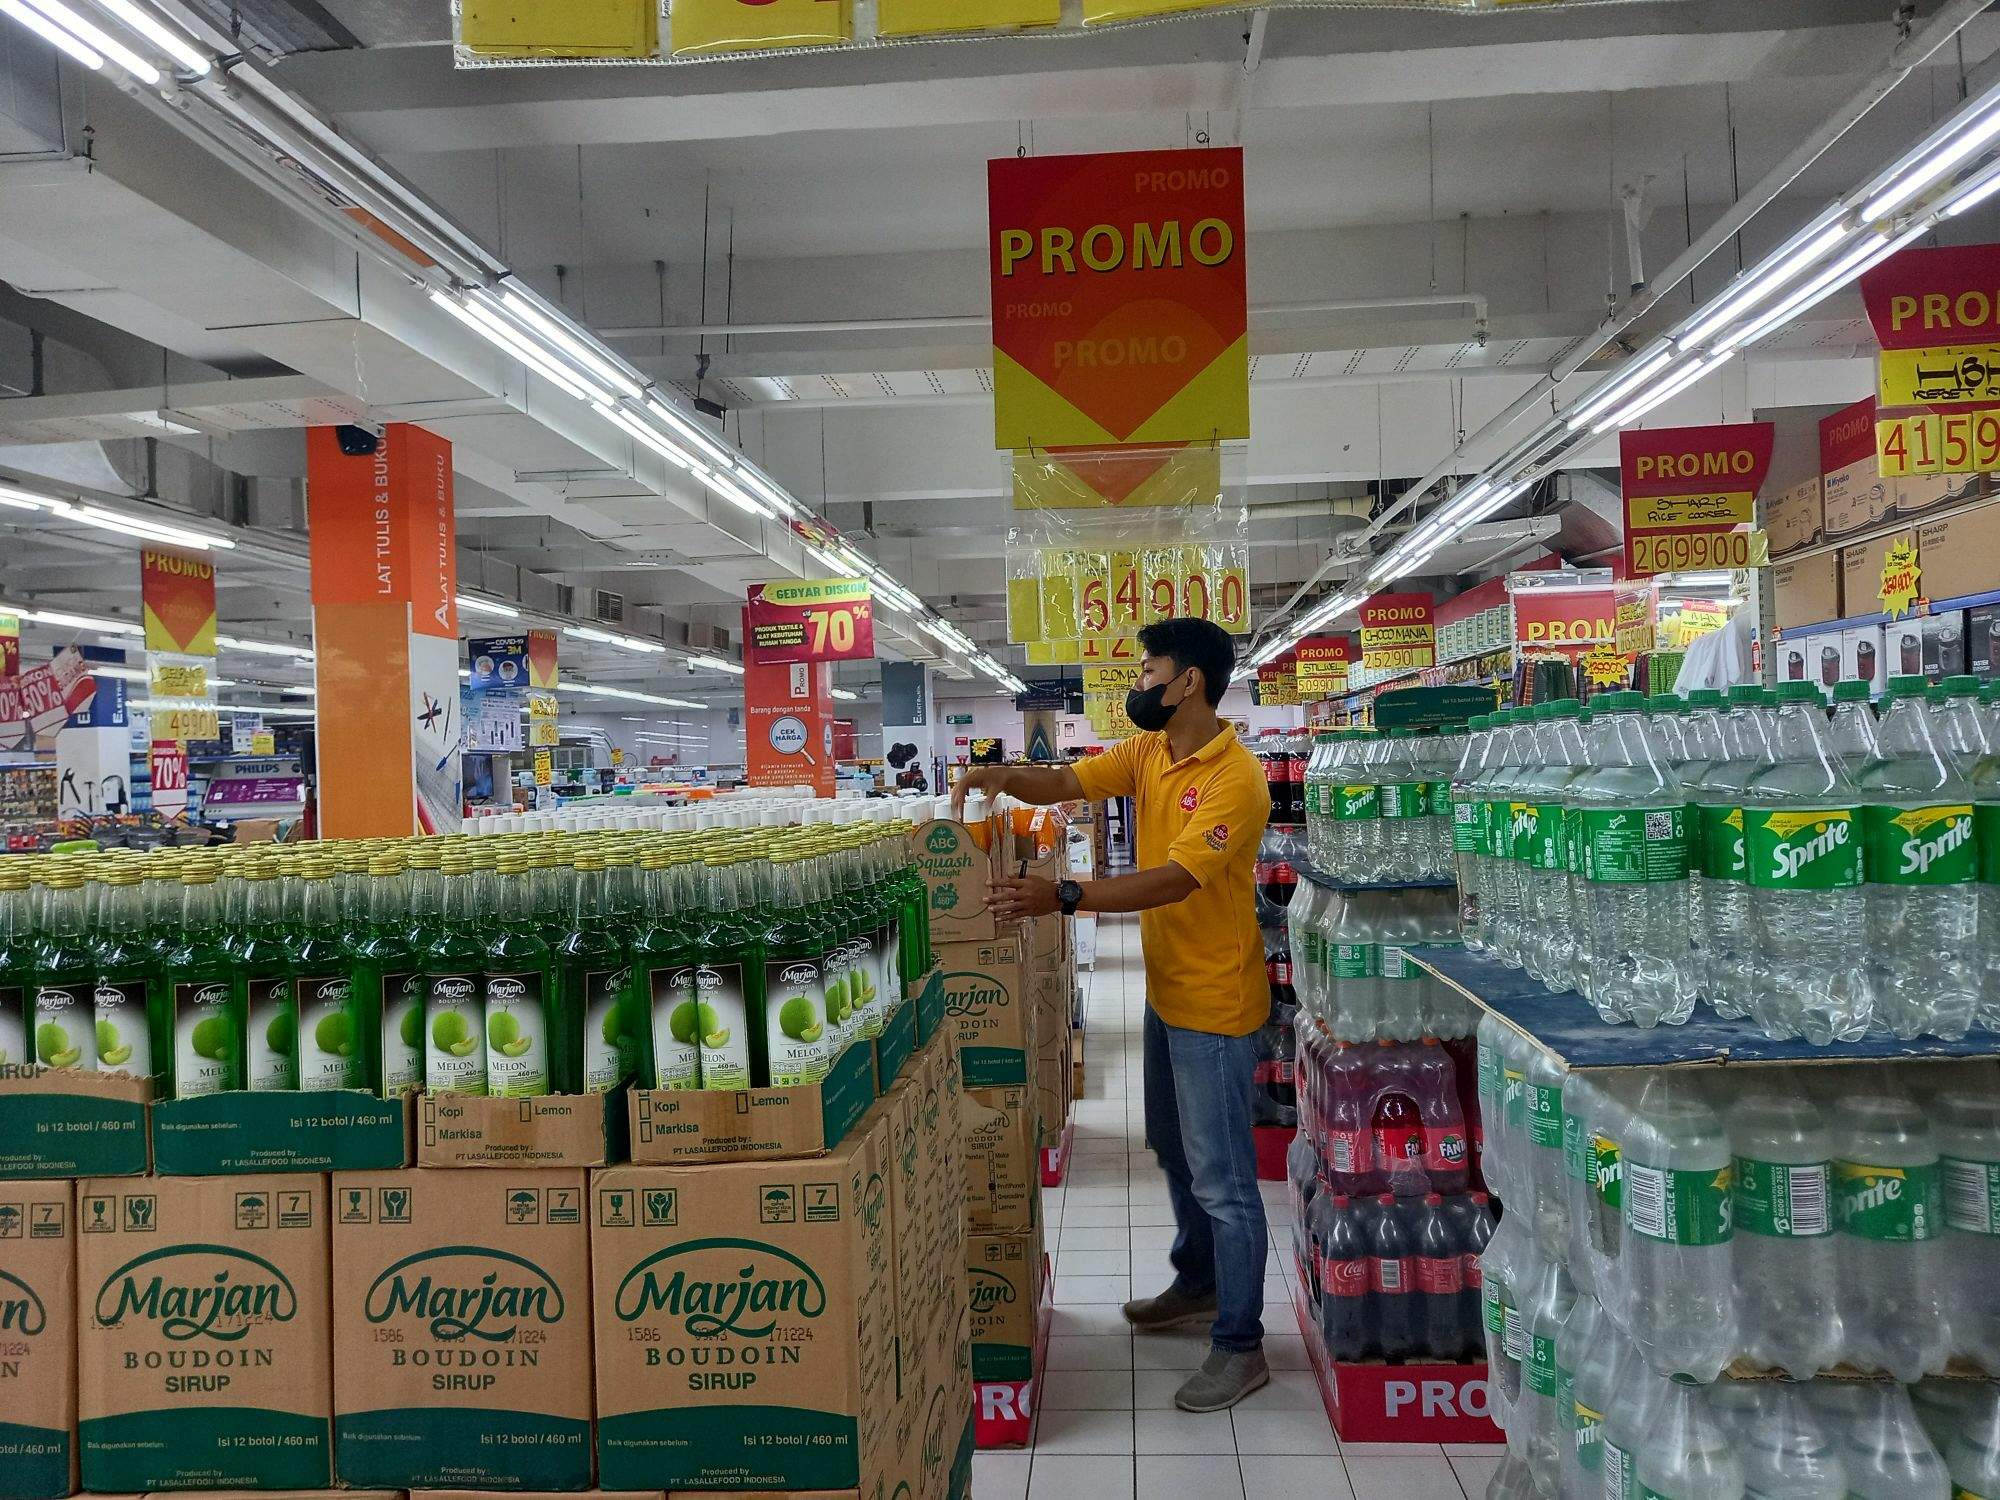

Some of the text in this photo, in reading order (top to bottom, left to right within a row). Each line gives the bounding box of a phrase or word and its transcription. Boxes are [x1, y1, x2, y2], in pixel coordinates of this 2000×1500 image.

[1135, 168, 1229, 193] PROMO
[1001, 218, 1234, 276] PROMO
[1006, 301, 1072, 320] PROMO
[1891, 291, 2000, 331] PRO
[1054, 335, 1186, 368] PROMO
[1828, 415, 1869, 448] PROMO
[1637, 450, 1754, 480] PROMO
[437, 454, 446, 501] BUKU
[375, 491, 388, 504] &
[1657, 496, 1727, 511] SHARP
[1648, 511, 1683, 522] RICE
[376, 509, 390, 558] TULIS
[1922, 523, 1949, 537] SHARP
[438, 523, 447, 568] TULIS
[1634, 535, 1748, 571] 269900
[1846, 547, 1867, 559] SHARP
[145, 553, 213, 579] PROMO
[377, 564, 391, 594] LAT
[776, 582, 867, 599] GEBYAR DISKON
[434, 571, 450, 629] ALAT
[1083, 569, 1242, 631] 64900
[1367, 606, 1426, 622] PROMO
[1364, 627, 1429, 641] CHOCO MANIA
[1528, 618, 1616, 642] PROM
[507, 645, 522, 655] 3M
[1301, 647, 1344, 658] PROMO
[1364, 650, 1412, 669] 25290
[794, 667, 805, 695] PROMO
[1099, 668, 1139, 683] ROMA
[750, 704, 811, 715] Barang dengan tanda
[153, 757, 185, 789] 70%
[235, 763, 280, 774] PHILIPS
[1181, 795, 1196, 808] ABC
[1345, 790, 1376, 816] Sprite
[929, 837, 956, 849] ABC
[1772, 821, 1849, 879] Sprite
[1900, 815, 1972, 875] Sprite
[916, 852, 974, 870] Squash
[933, 868, 961, 879] Delight
[780, 963, 819, 985] Marjan
[433, 977, 475, 998] Marjan
[487, 978, 526, 998] Marjan
[36, 989, 75, 1010] Marjan
[945, 982, 1009, 1017] arjan
[959, 1019, 999, 1029] DOIN
[958, 1032, 979, 1040] RUP
[787, 1046, 822, 1058] MELON
[437, 1061, 474, 1071] MELON
[492, 1061, 527, 1072] MELON
[439, 1106, 572, 1118] Kopi Lemon
[654, 1095, 789, 1113] Kopi Lemon
[37, 1121, 121, 1133] Isi 12 botol 460
[290, 1115, 377, 1128] Isi 12 botol 460
[655, 1122, 699, 1134] Markisa
[439, 1128, 482, 1139] Markisa
[702, 1136, 736, 1145] Produced
[485, 1144, 519, 1152] Produced
[684, 1143, 782, 1154] LASALLEFOOD INDONESIA
[971, 1142, 996, 1151] SIRUP
[1404, 1141, 1420, 1158] FAN
[1439, 1139, 1467, 1158] FANT
[234, 1157, 332, 1167] LASALLEFOOD INDONESIA
[467, 1151, 564, 1161] LASALLEFOOD INDONESIA
[37, 1161, 77, 1169] INDONESIA
[1596, 1158, 1622, 1192] Spri
[289, 1196, 300, 1211] 7
[559, 1193, 569, 1208] 7
[815, 1189, 827, 1206] 7
[1665, 1172, 1677, 1240] RECYCLE ME
[1843, 1178, 1902, 1224] prite
[1990, 1168, 2000, 1234] RECYCLE ME
[42, 1208, 53, 1223] 7
[97, 1266, 296, 1341] Marjan
[365, 1266, 564, 1341] Marjan
[615, 1261, 826, 1338] Marjan
[373, 1329, 404, 1343] 1586
[627, 1327, 661, 1341] 1586
[124, 1349, 274, 1369] BOUDOIN
[392, 1349, 539, 1367] BOUDOIN
[645, 1346, 801, 1366] BOUDOIN
[165, 1375, 231, 1392] SIRUP
[432, 1374, 496, 1391] SIRUP
[688, 1372, 757, 1390] SIRUP
[1384, 1380, 1489, 1418] PRO
[217, 1435, 304, 1447] Isi 12 botol 460
[480, 1433, 566, 1444] Isi 12 botol 460
[744, 1434, 832, 1445] Isi 12 botol 460
[26, 1443, 45, 1454] 460
[683, 1475, 786, 1485] LASALLEFOOD INDONESIA
[701, 1468, 738, 1476] Produced
[217, 1477, 258, 1485] INDONESIA
